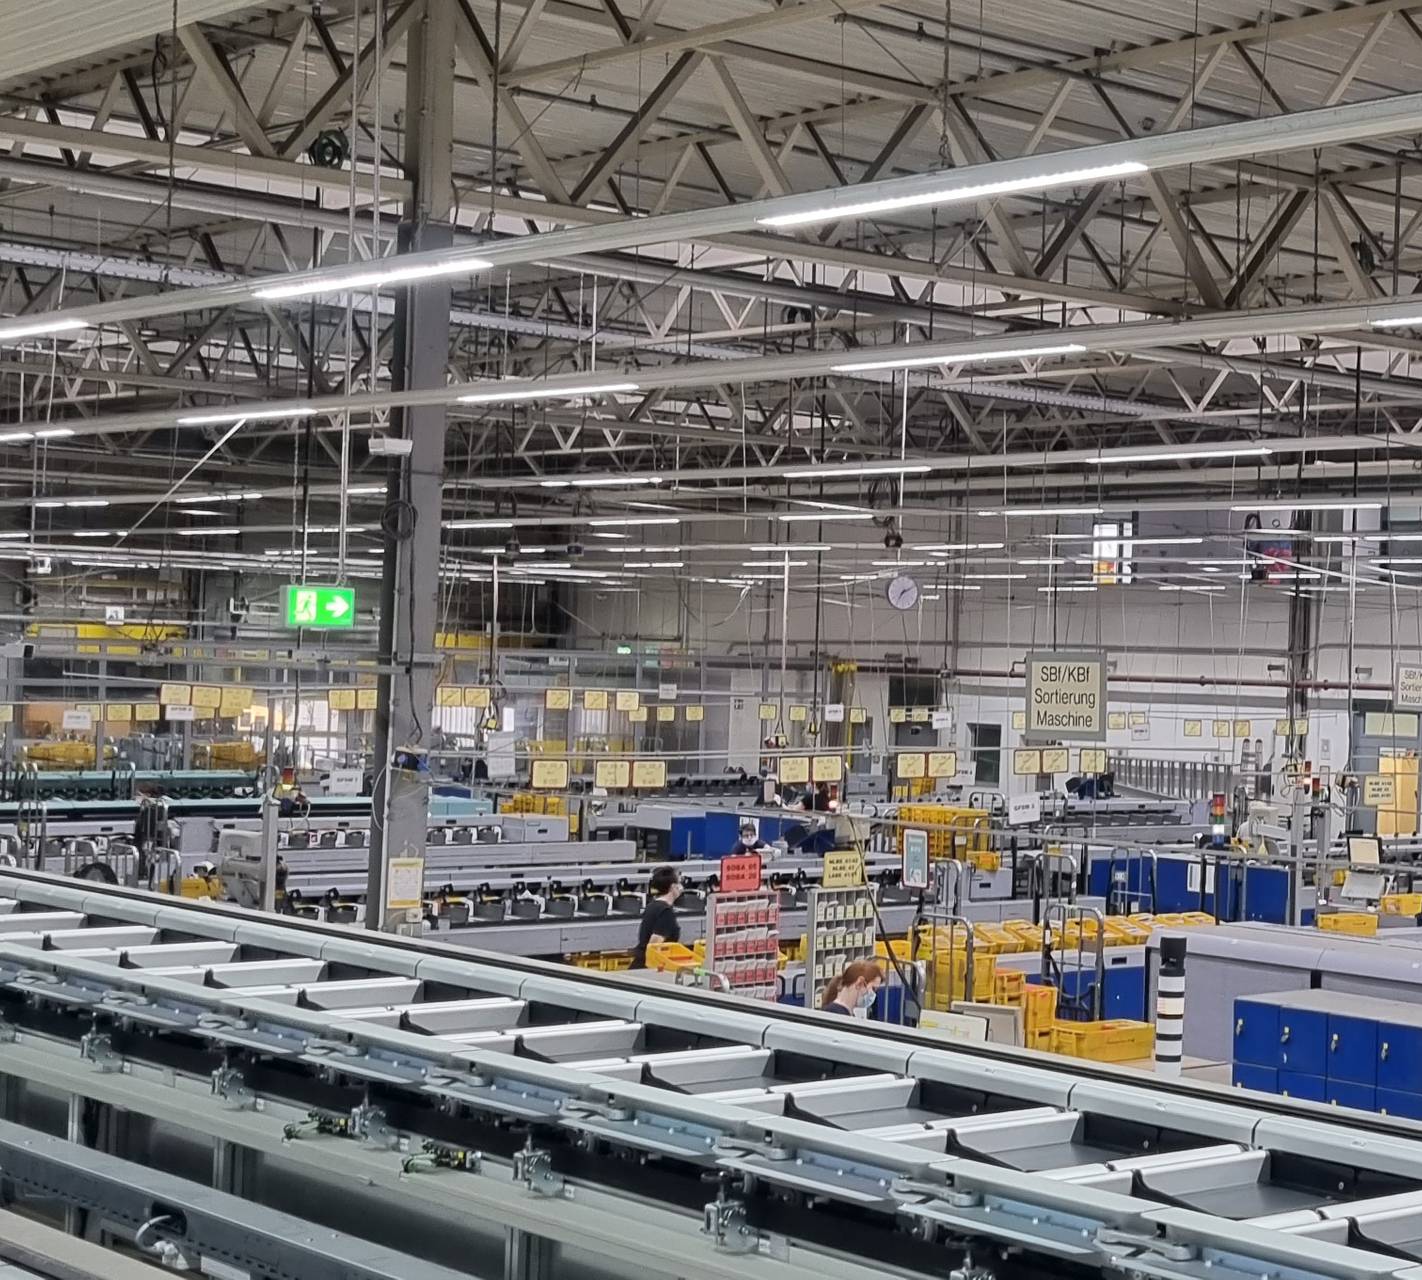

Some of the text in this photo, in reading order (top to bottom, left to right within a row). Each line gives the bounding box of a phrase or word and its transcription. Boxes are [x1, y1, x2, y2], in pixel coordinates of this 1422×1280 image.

[1040, 664, 1090, 683] SBf/KBf
[1034, 687, 1096, 709] Sortierung
[1036, 709, 1093, 728] Maschine
